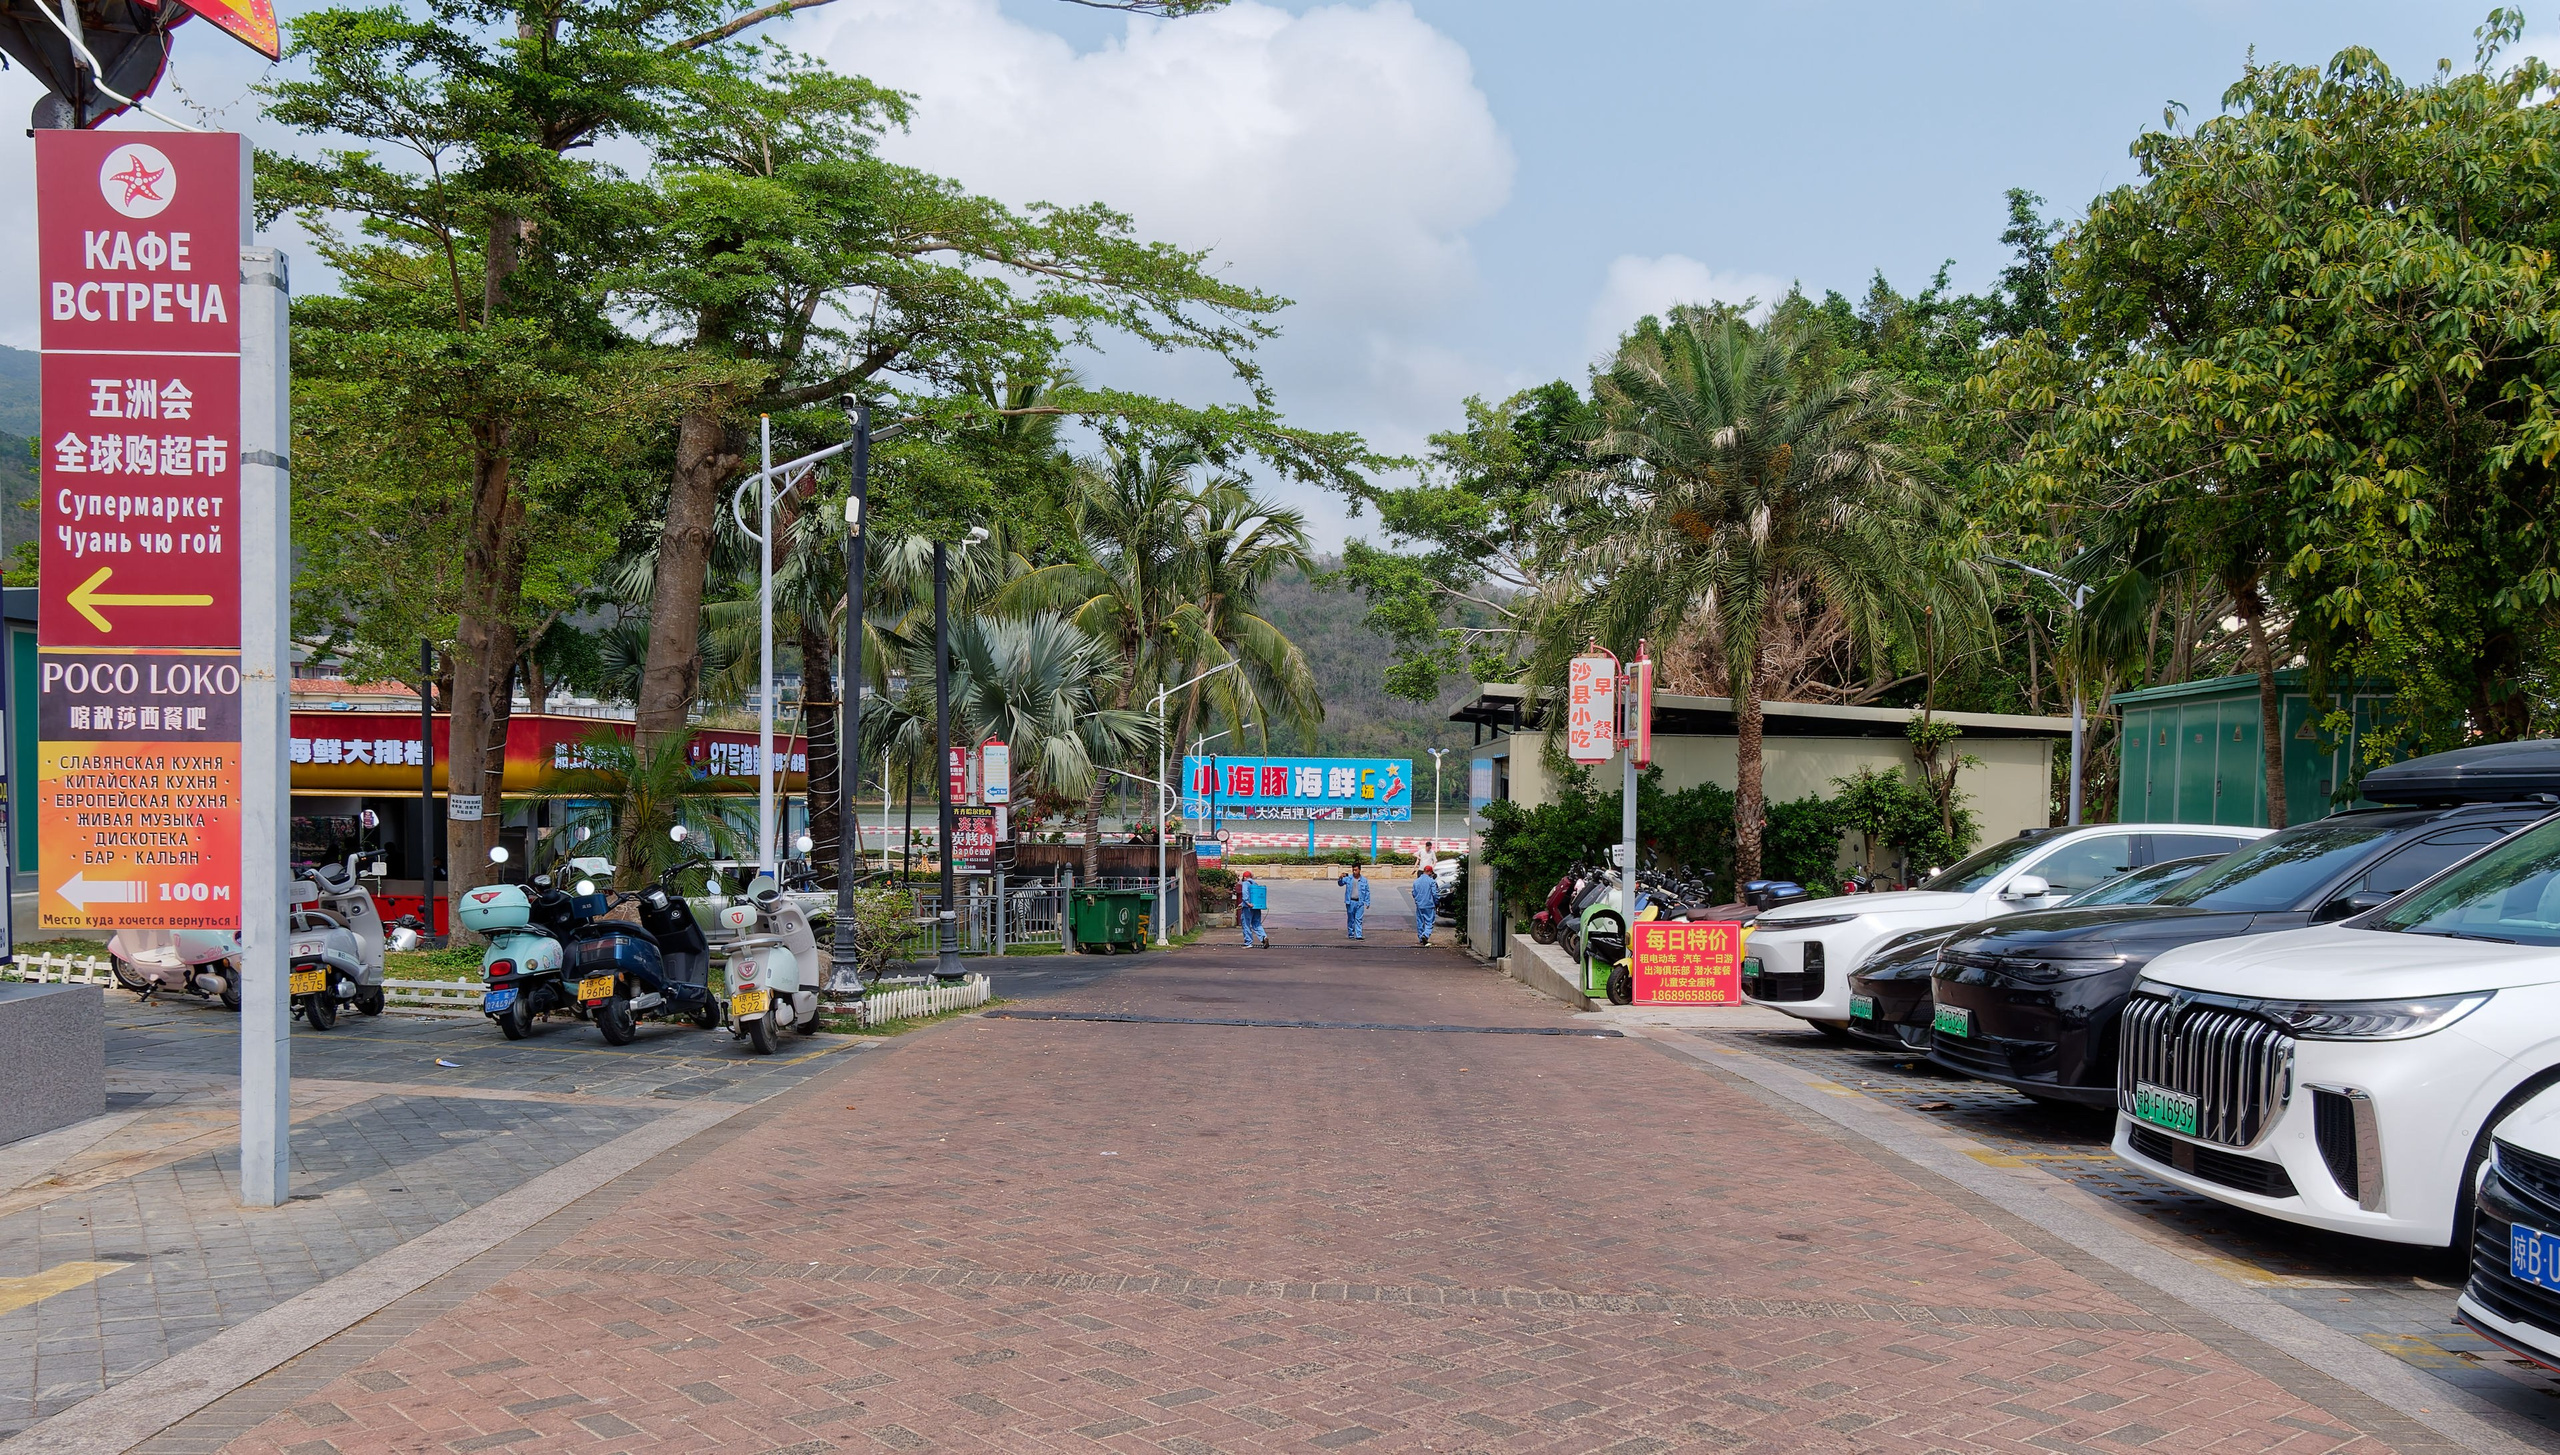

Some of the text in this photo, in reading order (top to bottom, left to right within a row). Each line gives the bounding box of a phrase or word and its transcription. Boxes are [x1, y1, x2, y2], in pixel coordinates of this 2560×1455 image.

[85, 230, 191, 271] КАФЕ
[52, 281, 228, 323] ВСТРЕЧА
[89, 378, 193, 421] 五洲会
[54, 431, 228, 477] 全球购超市
[58, 488, 223, 523] Супермаркет
[58, 525, 222, 558] Чуань чю гой
[42, 662, 240, 695] POCO LOKO
[1571, 662, 1591, 748] 沙县小吃
[1593, 678, 1612, 739] 早餐
[70, 705, 207, 731] 喀秋莎西餐吧
[59, 755, 223, 771] СЛАВЯНСКАЯ КУХНЯ
[64, 772, 217, 790] КИТАЙСКАЯ КУХНЯ
[55, 791, 228, 809] ЕВРОПЕЙСКАЯ КУХНЯ
[76, 812, 206, 828] ЖИВАЯ МУЗЫКА
[94, 832, 189, 847] ДИСКОТЕКА
[952, 831, 993, 846] 炭烤肉
[83, 850, 199, 865] БАР КАЛЬЯН
[43, 914, 81, 925] Место
[86, 916, 114, 927] куда
[118, 917, 164, 926] хочется
[1646, 928, 1729, 951] 每日特价
[1640, 954, 1734, 964] 租电动车 汽车 一日游
[1644, 965, 1690, 975] 出海俱乐部
[1651, 990, 1725, 1001] 18689658866
